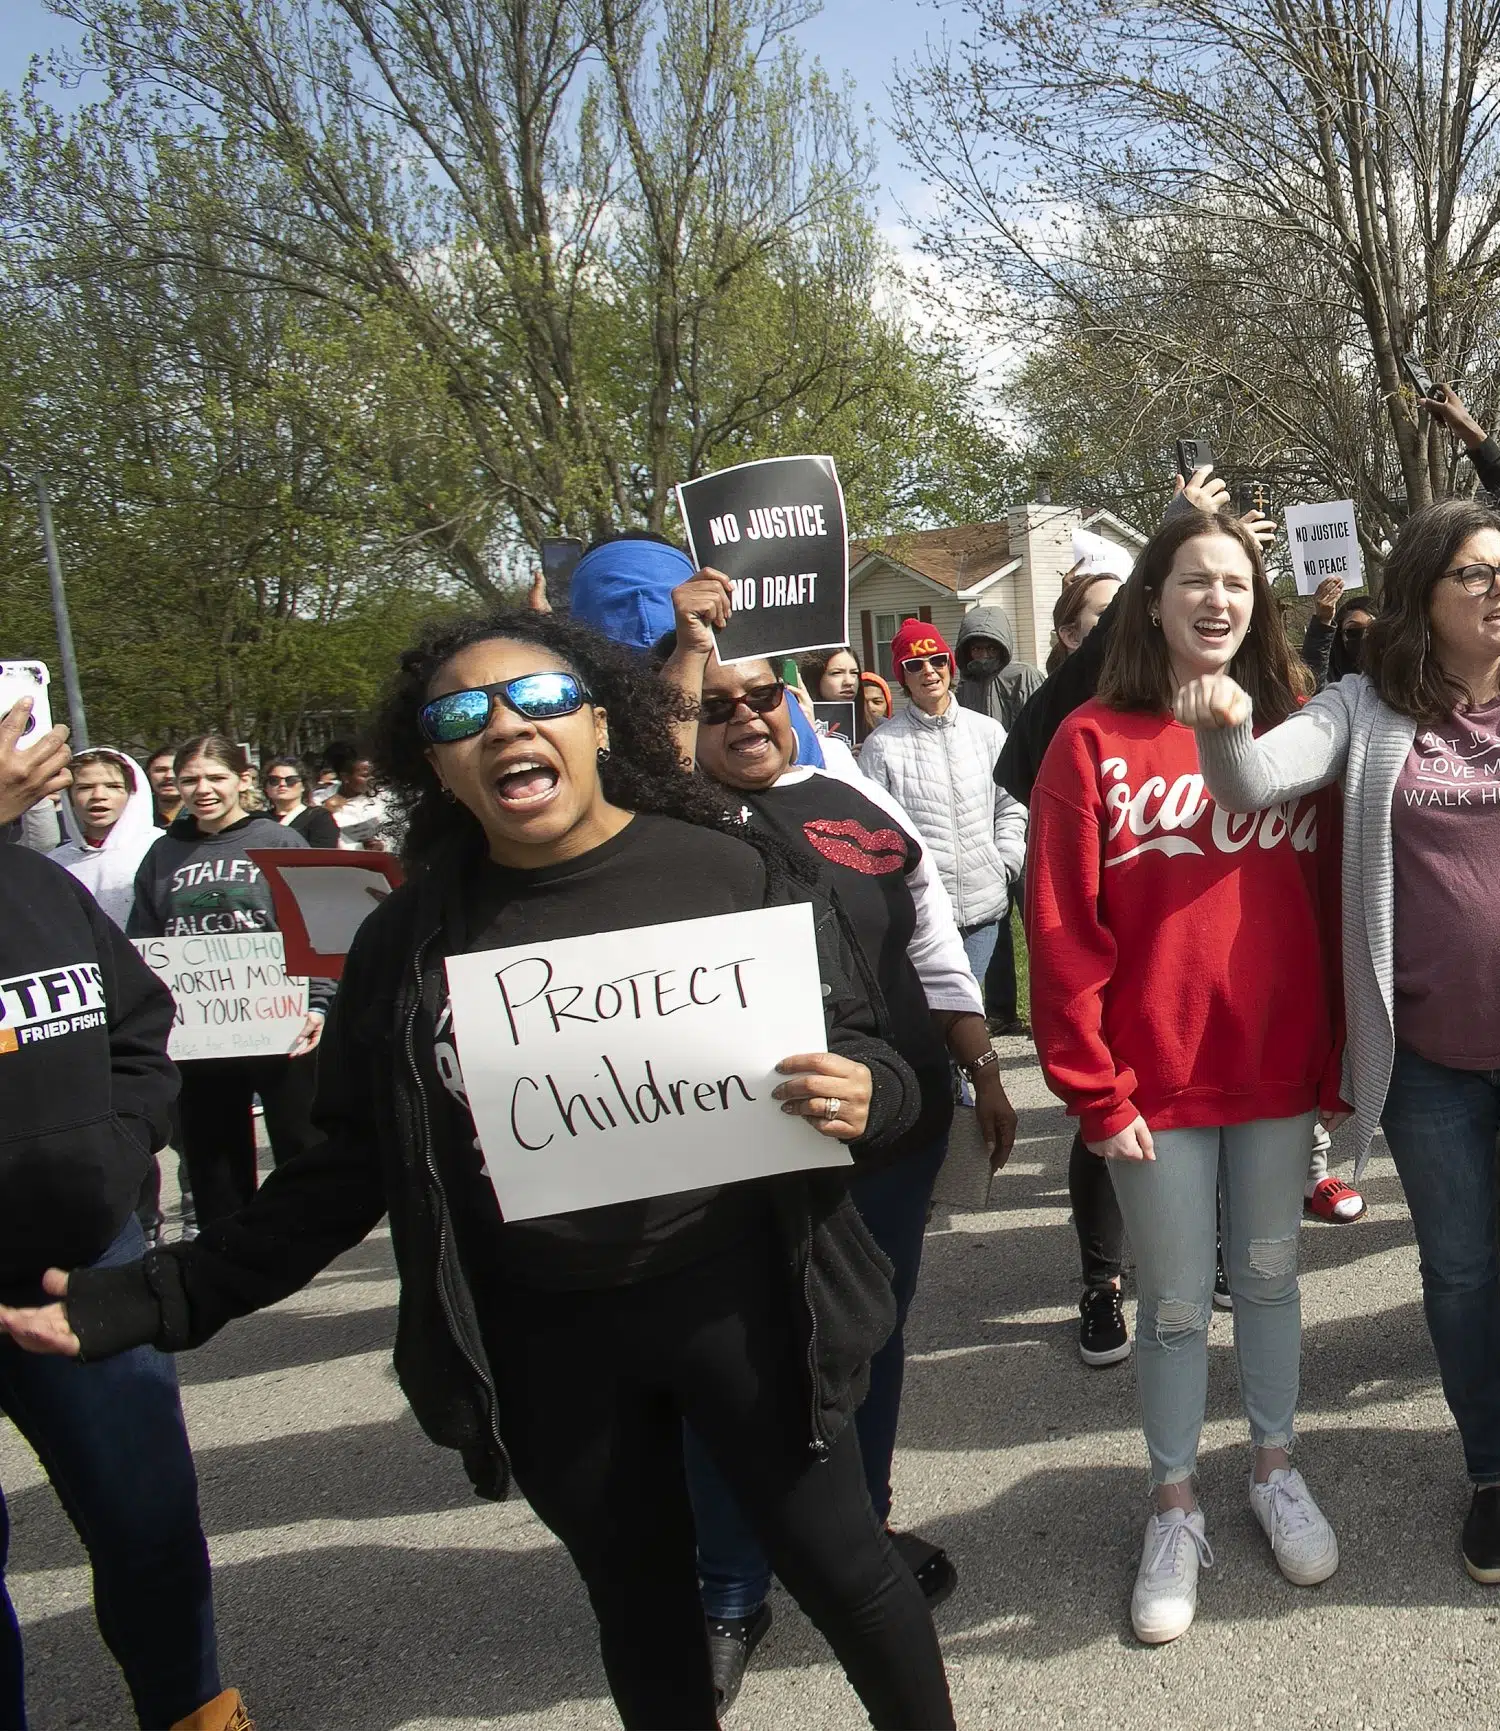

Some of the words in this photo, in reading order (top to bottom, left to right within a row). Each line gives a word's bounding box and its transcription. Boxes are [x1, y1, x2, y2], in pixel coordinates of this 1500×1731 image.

[709, 513, 741, 546] NO
[746, 504, 828, 540] JUSTICE
[1295, 526, 1308, 543] NO
[1311, 521, 1350, 542] JUSTICE
[1303, 560, 1317, 576] NO
[1318, 556, 1348, 575] PEACE
[730, 578, 757, 611] NO
[762, 572, 818, 608] DRAFT
[909, 638, 939, 657] KC
[1420, 757, 1476, 779] LOVE
[1404, 788, 1472, 807] WALK
[171, 859, 260, 892] STALEY
[164, 909, 267, 937] FALCONS
[183, 935, 283, 966] CHILDHO
[197, 997, 252, 1026] YOUR
[495, 957, 756, 1046] PROTECT
[21, 1021, 71, 1045] FRIED
[71, 1012, 100, 1032] FISH
[510, 1054, 757, 1151] Children
